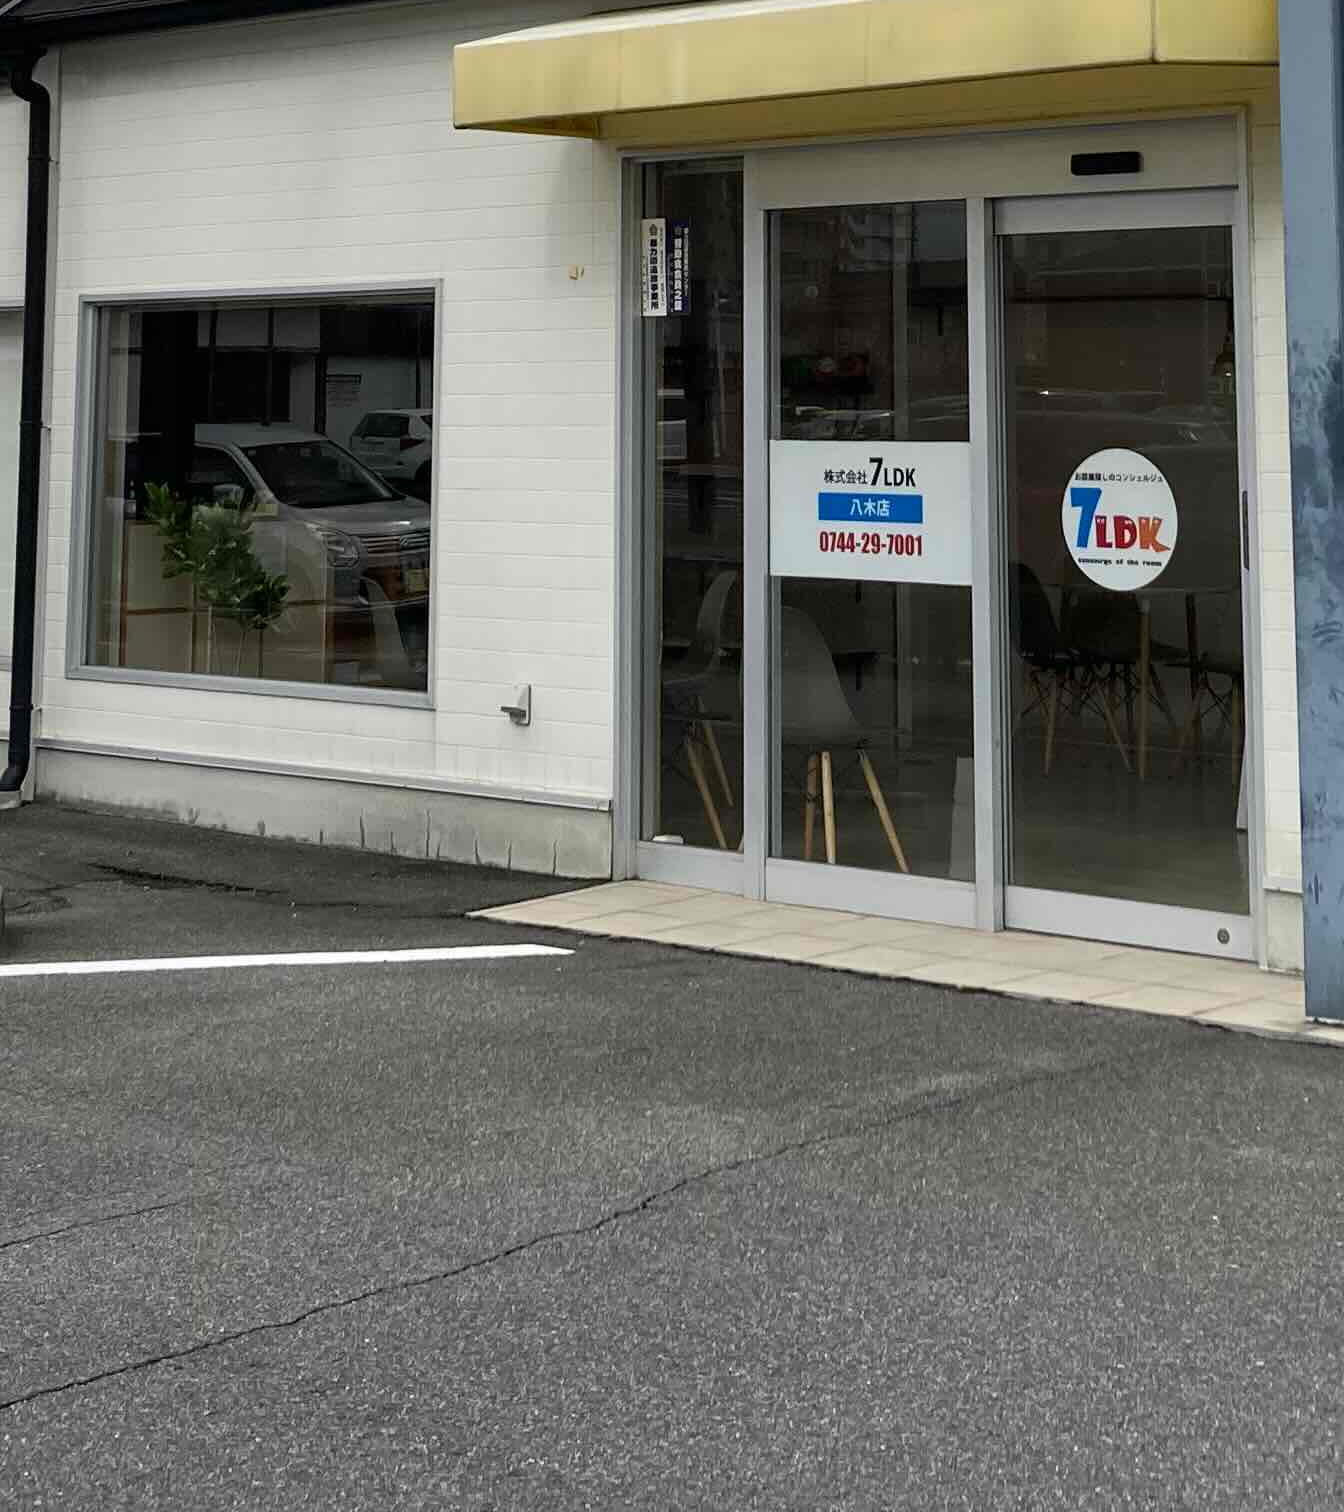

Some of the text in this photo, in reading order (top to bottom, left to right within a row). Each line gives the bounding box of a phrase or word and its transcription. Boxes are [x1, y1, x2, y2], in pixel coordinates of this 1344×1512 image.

[849, 497, 892, 517] 八木店
[1070, 487, 1172, 553] 7LDK
[819, 531, 923, 557] 0744-29-7001
